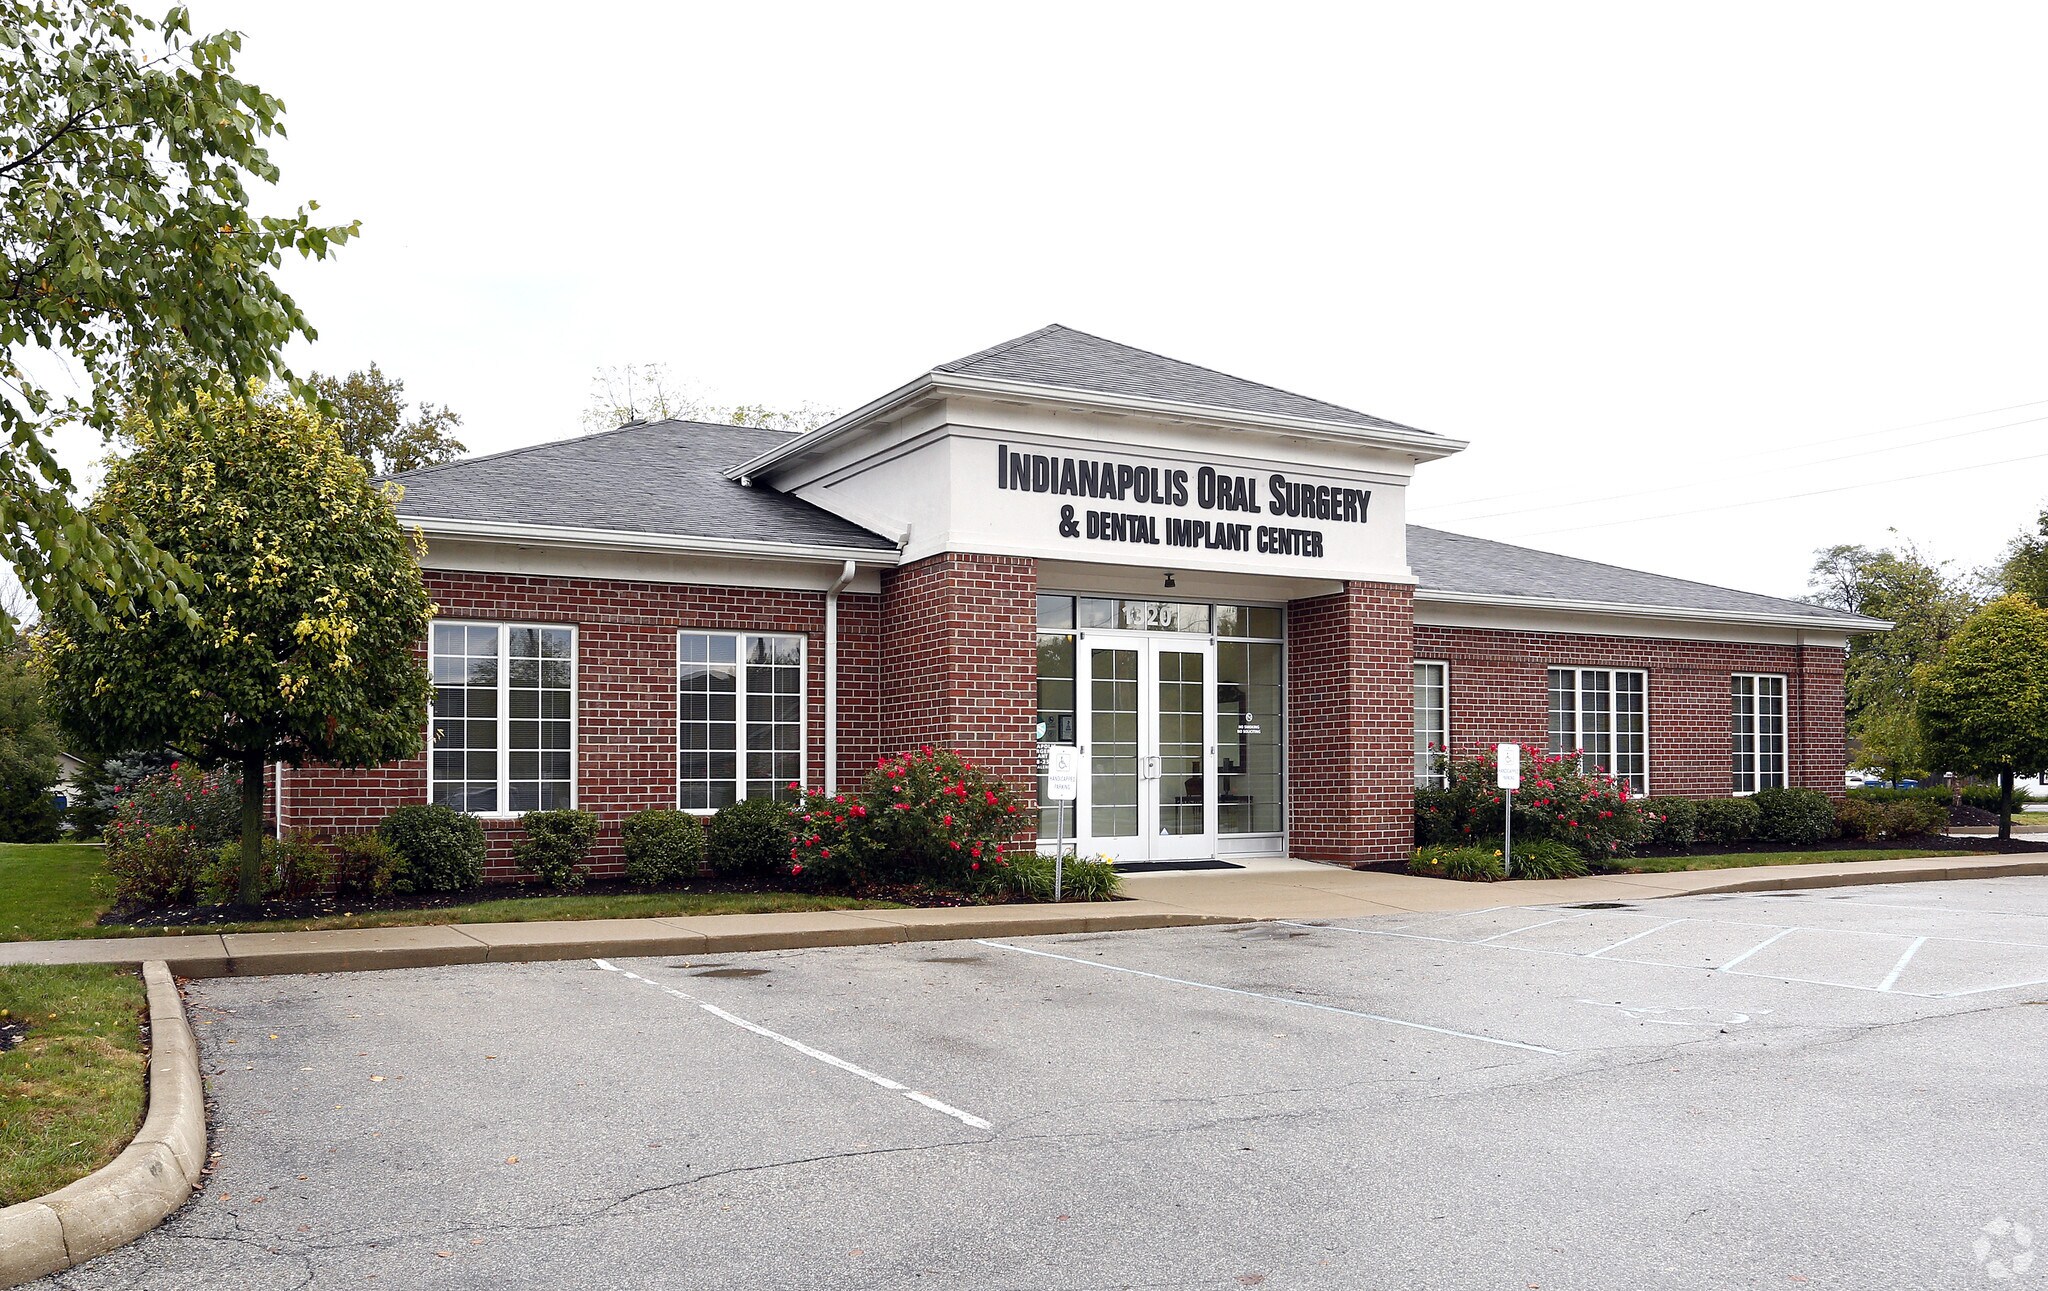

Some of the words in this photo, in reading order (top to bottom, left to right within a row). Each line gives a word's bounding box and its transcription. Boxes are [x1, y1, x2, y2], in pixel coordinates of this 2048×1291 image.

[998, 444, 1189, 507] INDIANAPOLIS
[1197, 465, 1262, 514] ORAL
[1268, 473, 1372, 524] SURGERY
[1058, 504, 1080, 539] &
[1086, 510, 1160, 545] DENTAL
[1165, 517, 1252, 552] IMPLANT
[1256, 525, 1324, 558] CENTER
